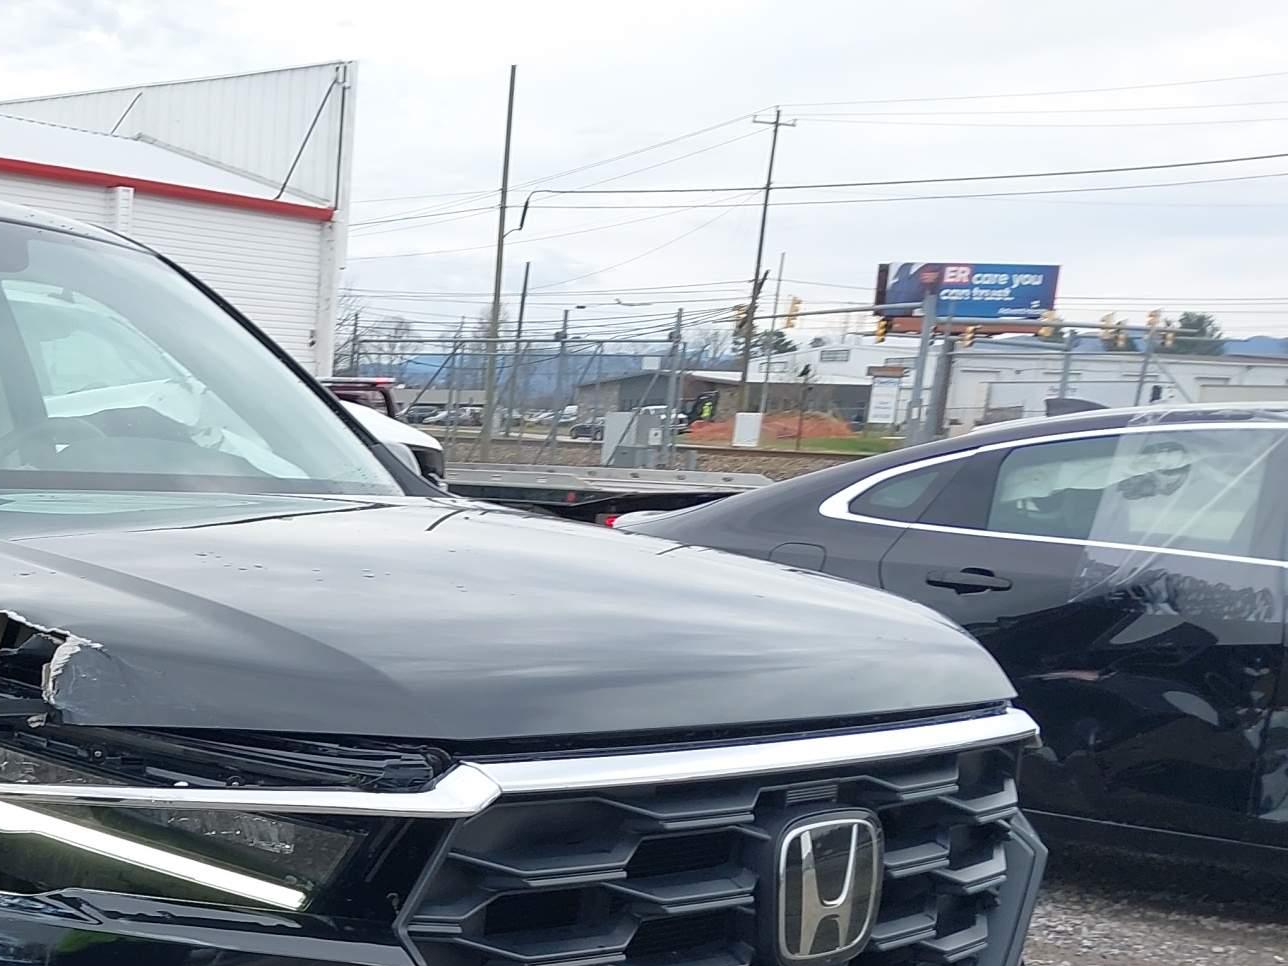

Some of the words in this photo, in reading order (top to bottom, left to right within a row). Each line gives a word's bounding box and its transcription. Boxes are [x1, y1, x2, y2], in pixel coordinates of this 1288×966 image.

[943, 266, 971, 283] ER
[971, 272, 1009, 286] care
[1012, 273, 1044, 289] you
[939, 287, 971, 301] can
